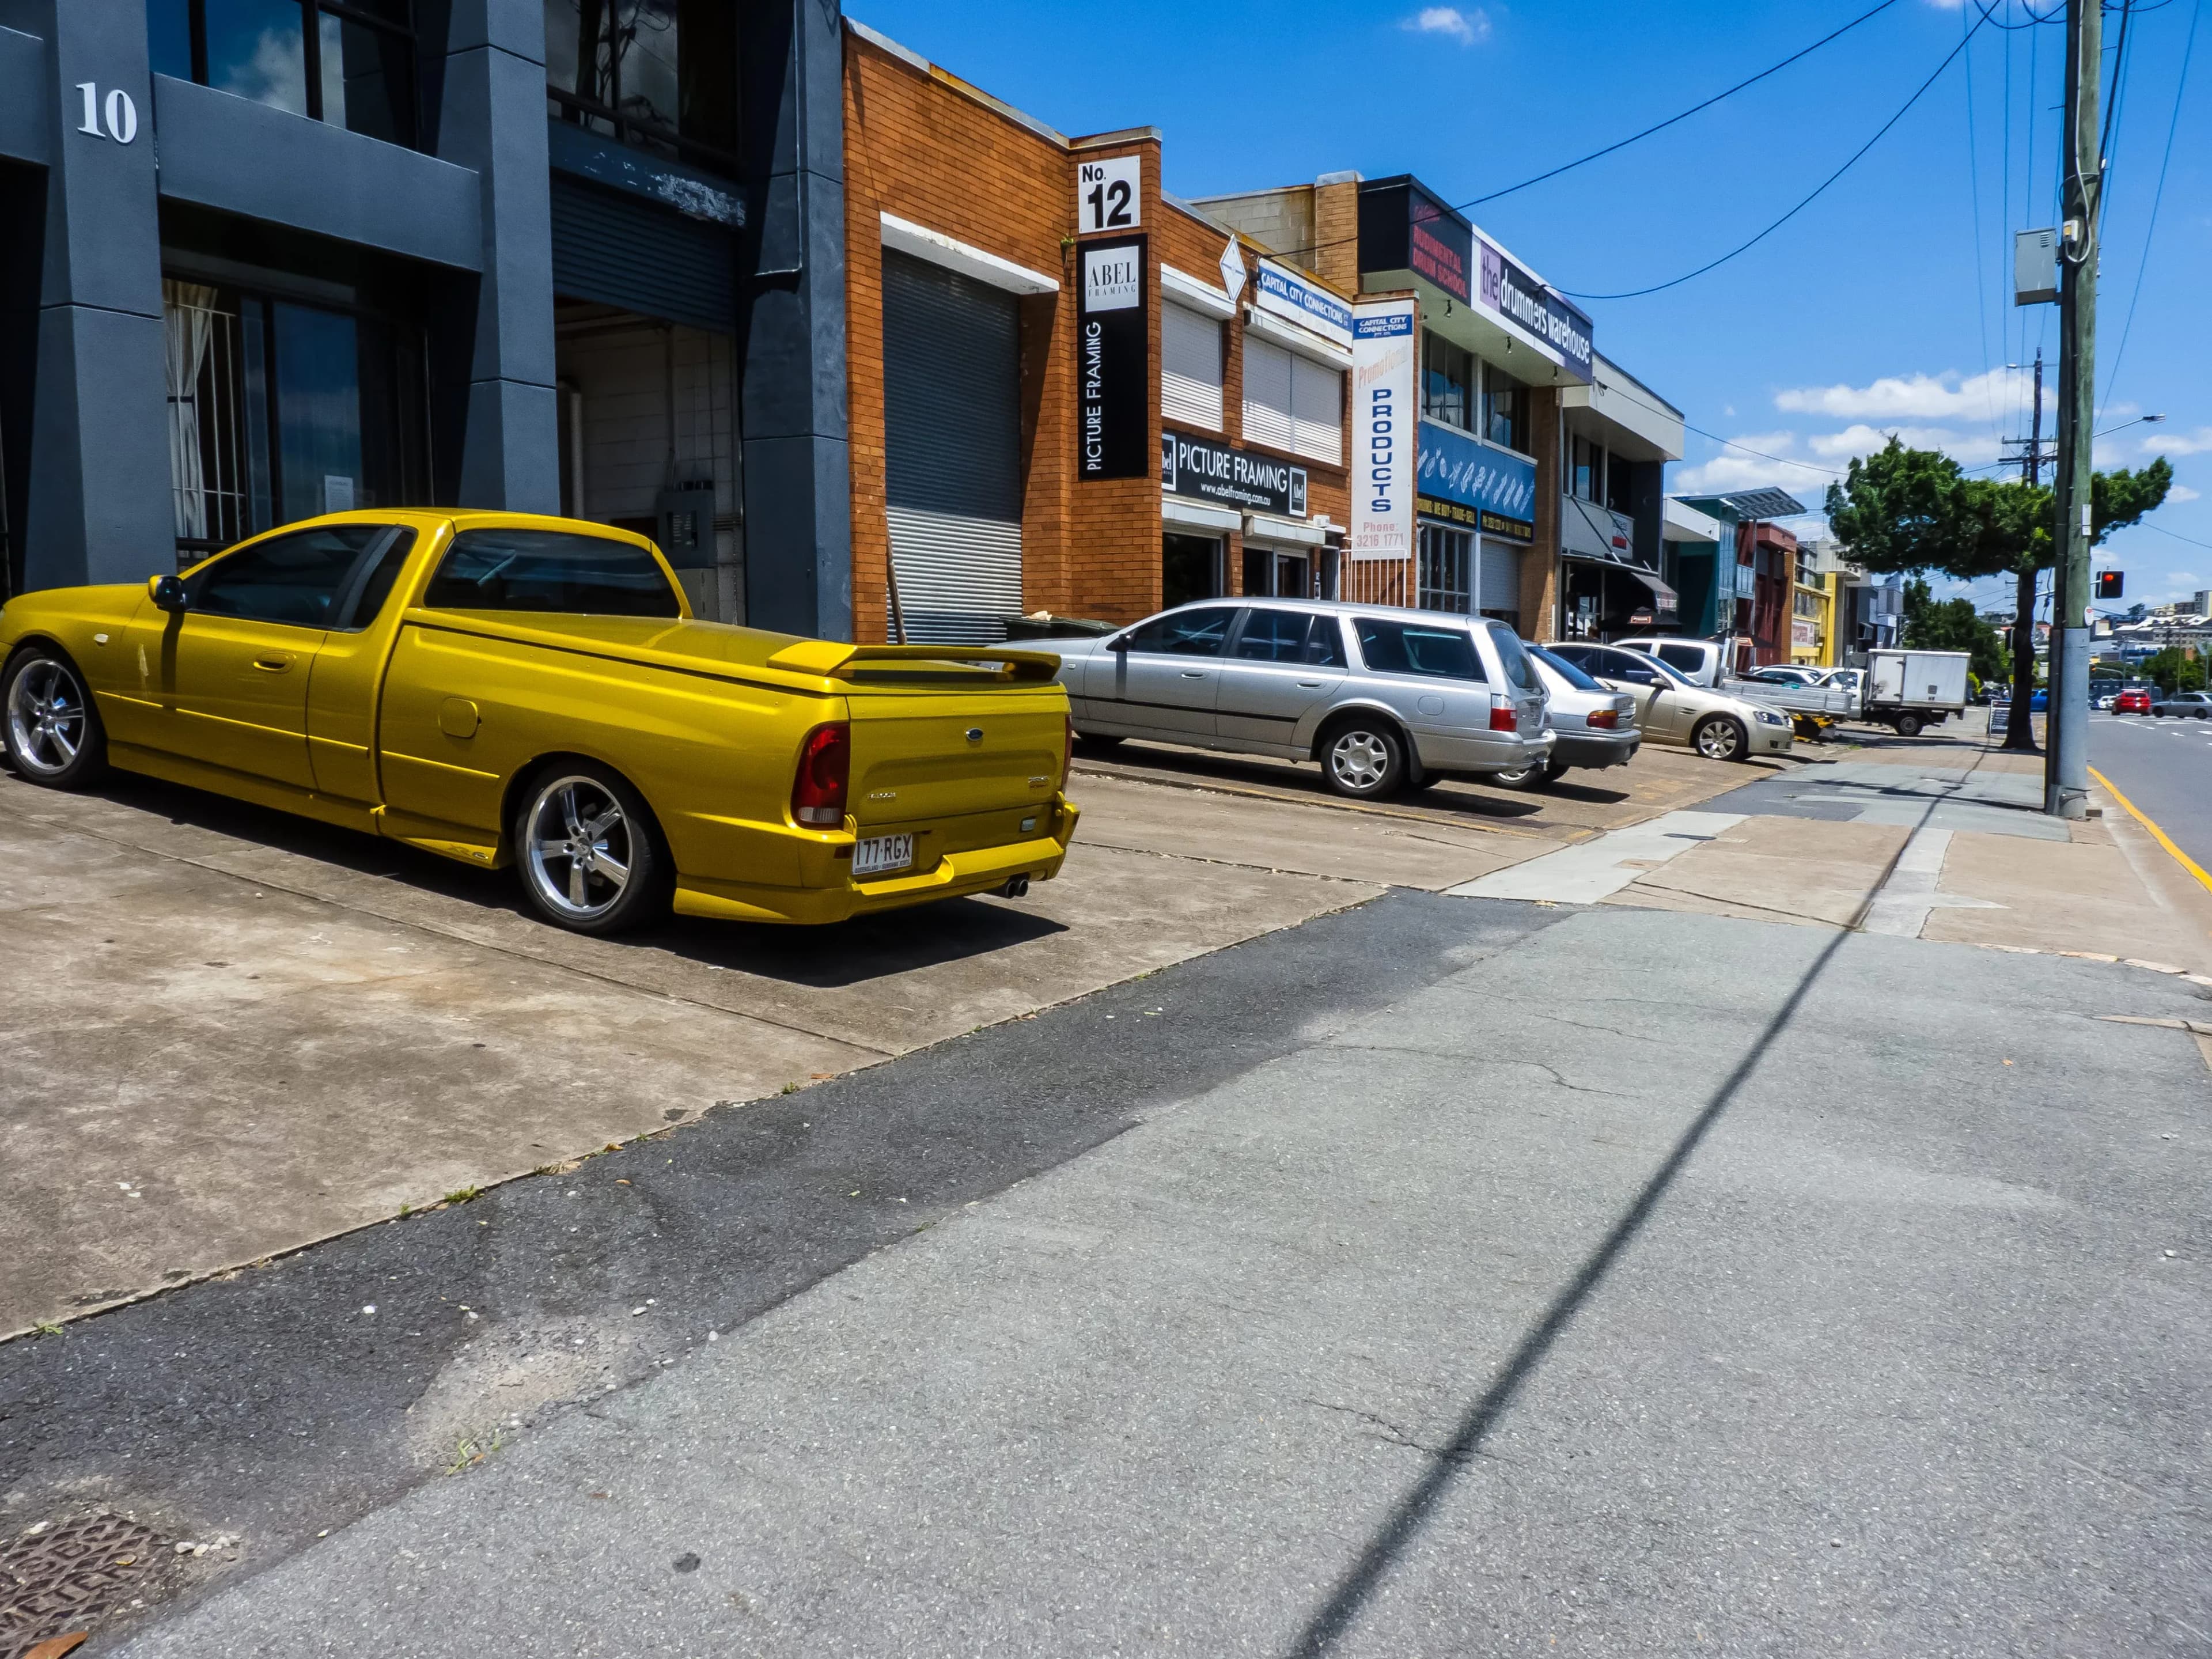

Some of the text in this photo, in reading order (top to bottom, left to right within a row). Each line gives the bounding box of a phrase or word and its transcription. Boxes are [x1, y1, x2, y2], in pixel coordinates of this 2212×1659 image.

[76, 82, 138, 143] 10
[1082, 165, 1107, 183] No.
[1088, 180, 1131, 229] 12
[1088, 285, 1136, 297] FRAMING
[1089, 262, 1136, 287] ABEL
[1261, 273, 1288, 297] CAPITAL
[1289, 286, 1304, 307] CITY
[1304, 294, 1343, 324] CONNECTIONS
[1482, 255, 1590, 365] the drummers warehouse
[1358, 323, 1407, 333] CONNECTIONS
[1360, 319, 1387, 327] CAPITAL
[1086, 321, 1101, 470] PICTURE FRAMING
[1180, 442, 1287, 493] PICTURE FRAMING
[1372, 389, 1392, 512] PRODUCTS
[1201, 482, 1271, 506] www.abelframing.com.au
[1357, 533, 1404, 547] 3216 1771
